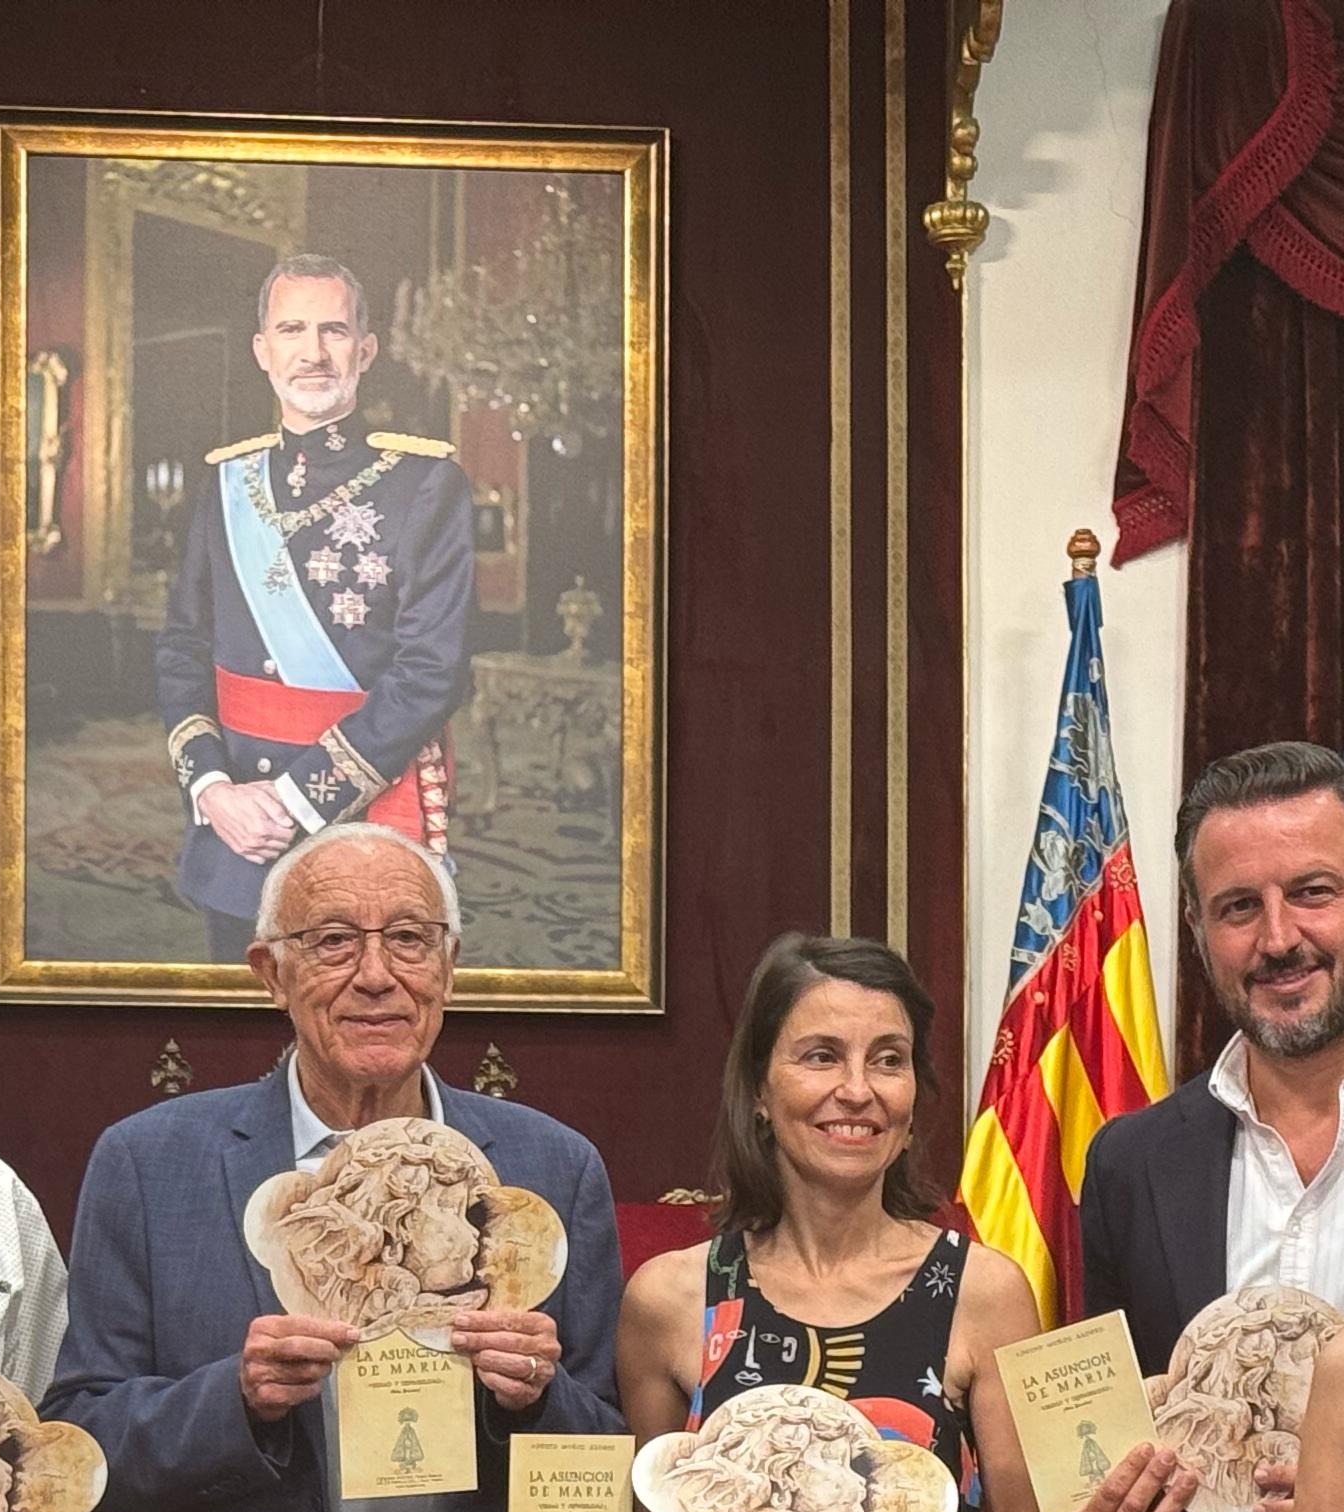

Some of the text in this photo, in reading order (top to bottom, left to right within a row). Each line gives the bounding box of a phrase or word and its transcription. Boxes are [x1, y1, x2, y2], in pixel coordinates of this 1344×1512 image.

[357, 1350, 373, 1362] LA
[357, 1360, 452, 1377] DE MARIA
[1022, 1376, 1039, 1390] LA
[1044, 1351, 1112, 1383] ASUNCION
[1026, 1387, 1049, 1403] DE
[1057, 1366, 1117, 1393] MARIA
[529, 1470, 614, 1483] LA ASUNCION
[529, 1485, 614, 1498] DE MARIA
